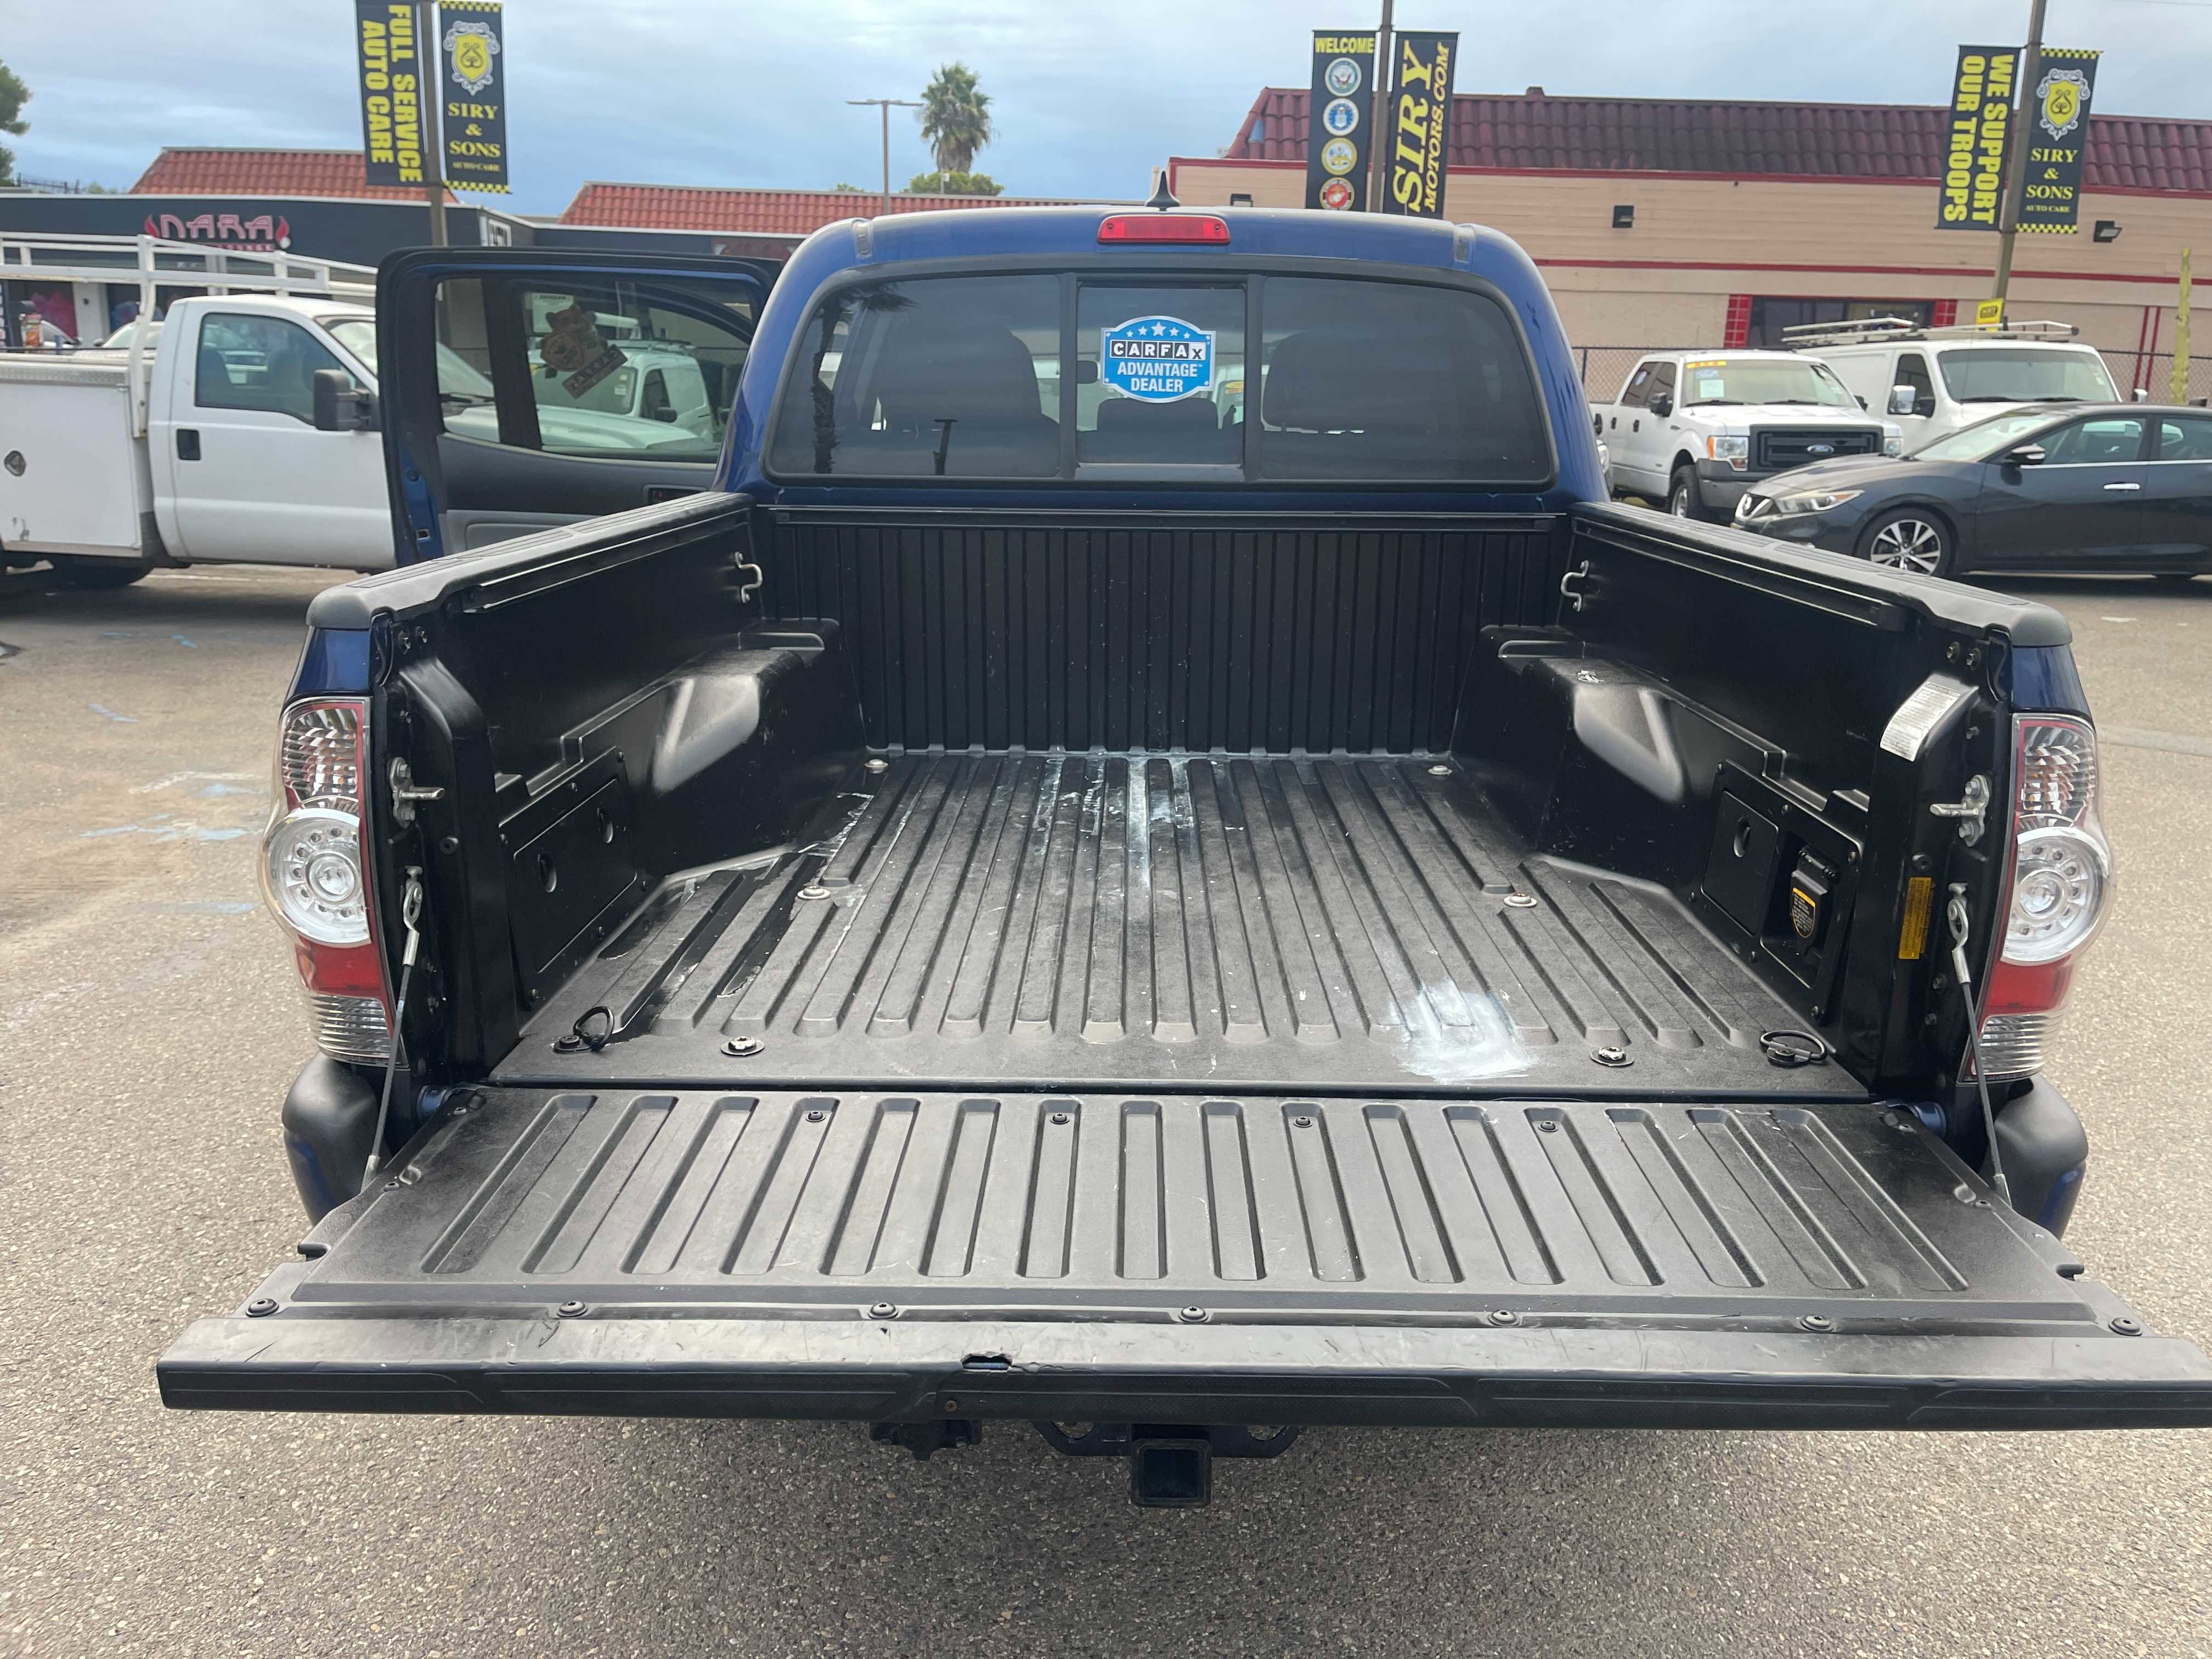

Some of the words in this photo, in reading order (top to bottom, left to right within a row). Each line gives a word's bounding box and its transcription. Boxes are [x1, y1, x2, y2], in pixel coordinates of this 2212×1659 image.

[388, 4, 414, 63] FULL
[362, 20, 390, 91] AUTO
[1314, 37, 1375, 53] WELCOME
[1956, 55, 1986, 112] OUR
[1987, 54, 2015, 98] WE
[448, 102, 499, 120] SIRY
[366, 95, 394, 163] CARE
[392, 74, 424, 183] SERVICE
[465, 123, 482, 137] &
[1393, 40, 1432, 213] SIRY
[1424, 41, 1449, 212] MOTORS.COM
[449, 140, 501, 158] SONS
[2031, 148, 2079, 163] SIRY
[1943, 116, 1978, 222] TROOPS
[1971, 102, 2008, 225] SUPPORT
[2043, 167, 2059, 180] &
[2025, 184, 2074, 200] SONS
[2048, 205, 2072, 213] CARE
[160, 214, 274, 239] NARA
[1113, 343, 1203, 359] CARFAX
[1117, 362, 1198, 377] ADVANTAGE
[1130, 377, 1183, 392] DEALER
